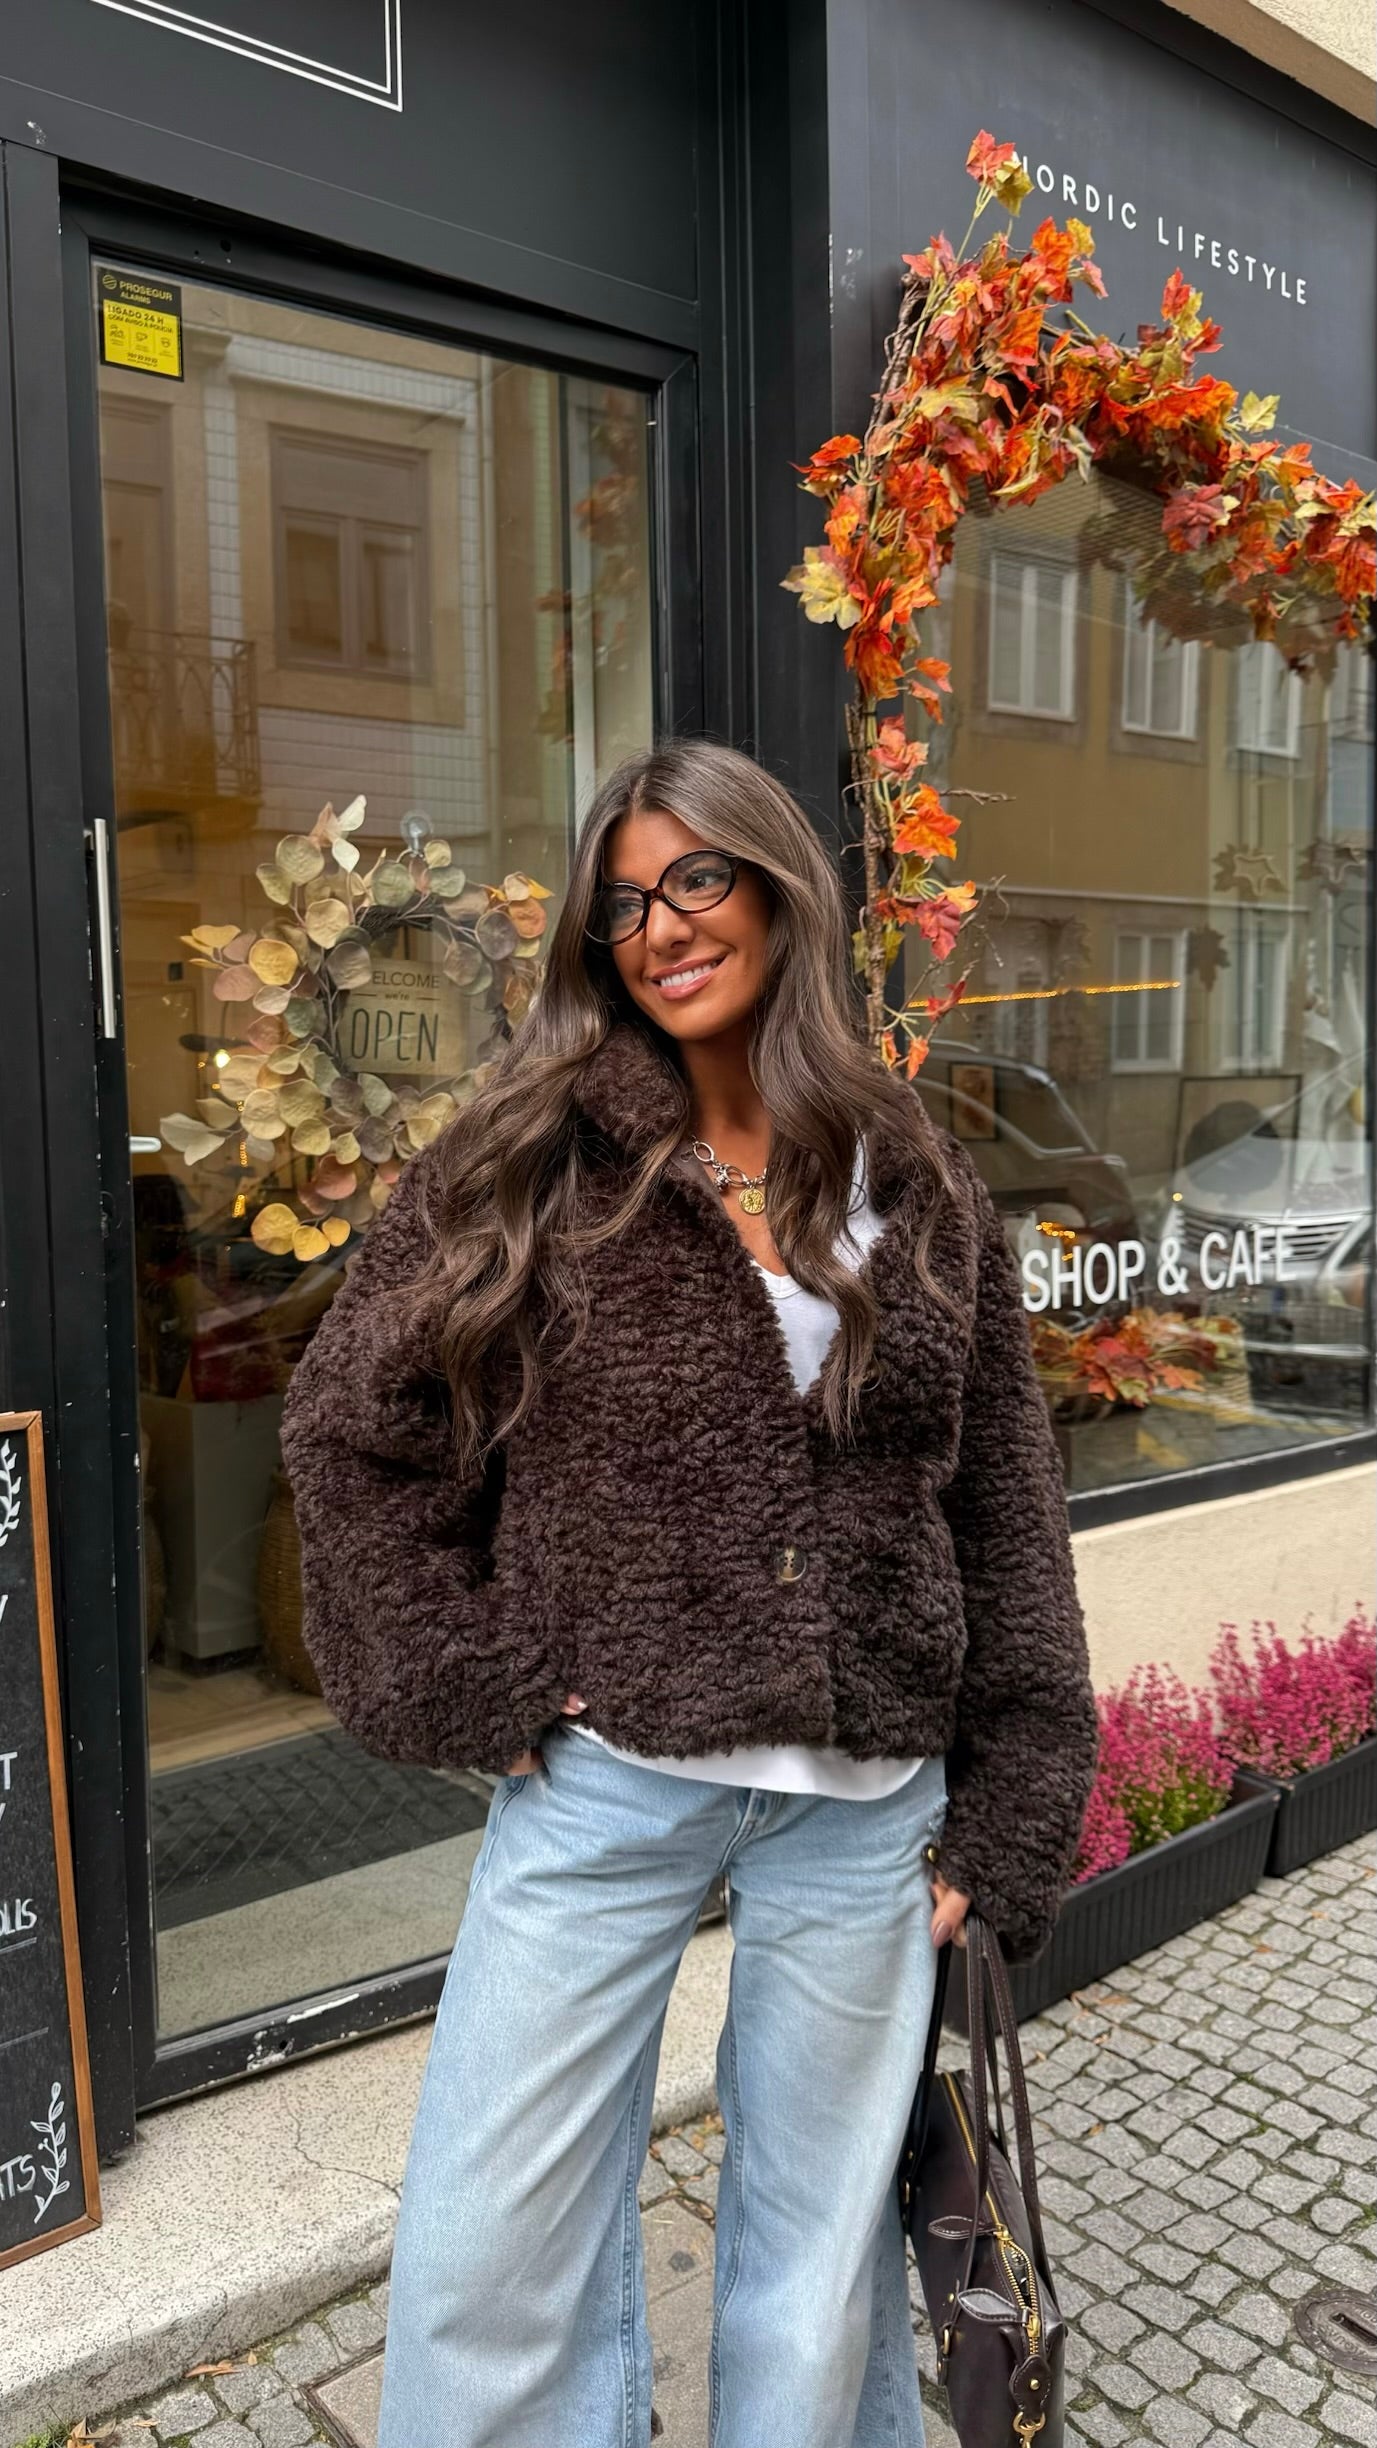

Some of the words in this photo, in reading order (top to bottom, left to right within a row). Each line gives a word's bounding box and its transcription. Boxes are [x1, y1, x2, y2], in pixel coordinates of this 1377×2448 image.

[1157, 216, 1307, 305] LIFESTYLE
[119, 280, 173, 302] PROSEGUR
[120, 291, 152, 305] ALARMS
[107, 304, 142, 319] LIGADO
[144, 313, 156, 322] 24
[371, 969, 441, 989] ELCOME
[350, 1007, 439, 1063] OPEN
[1021, 1239, 1146, 1313] SHOP
[1156, 1236, 1190, 1296] &
